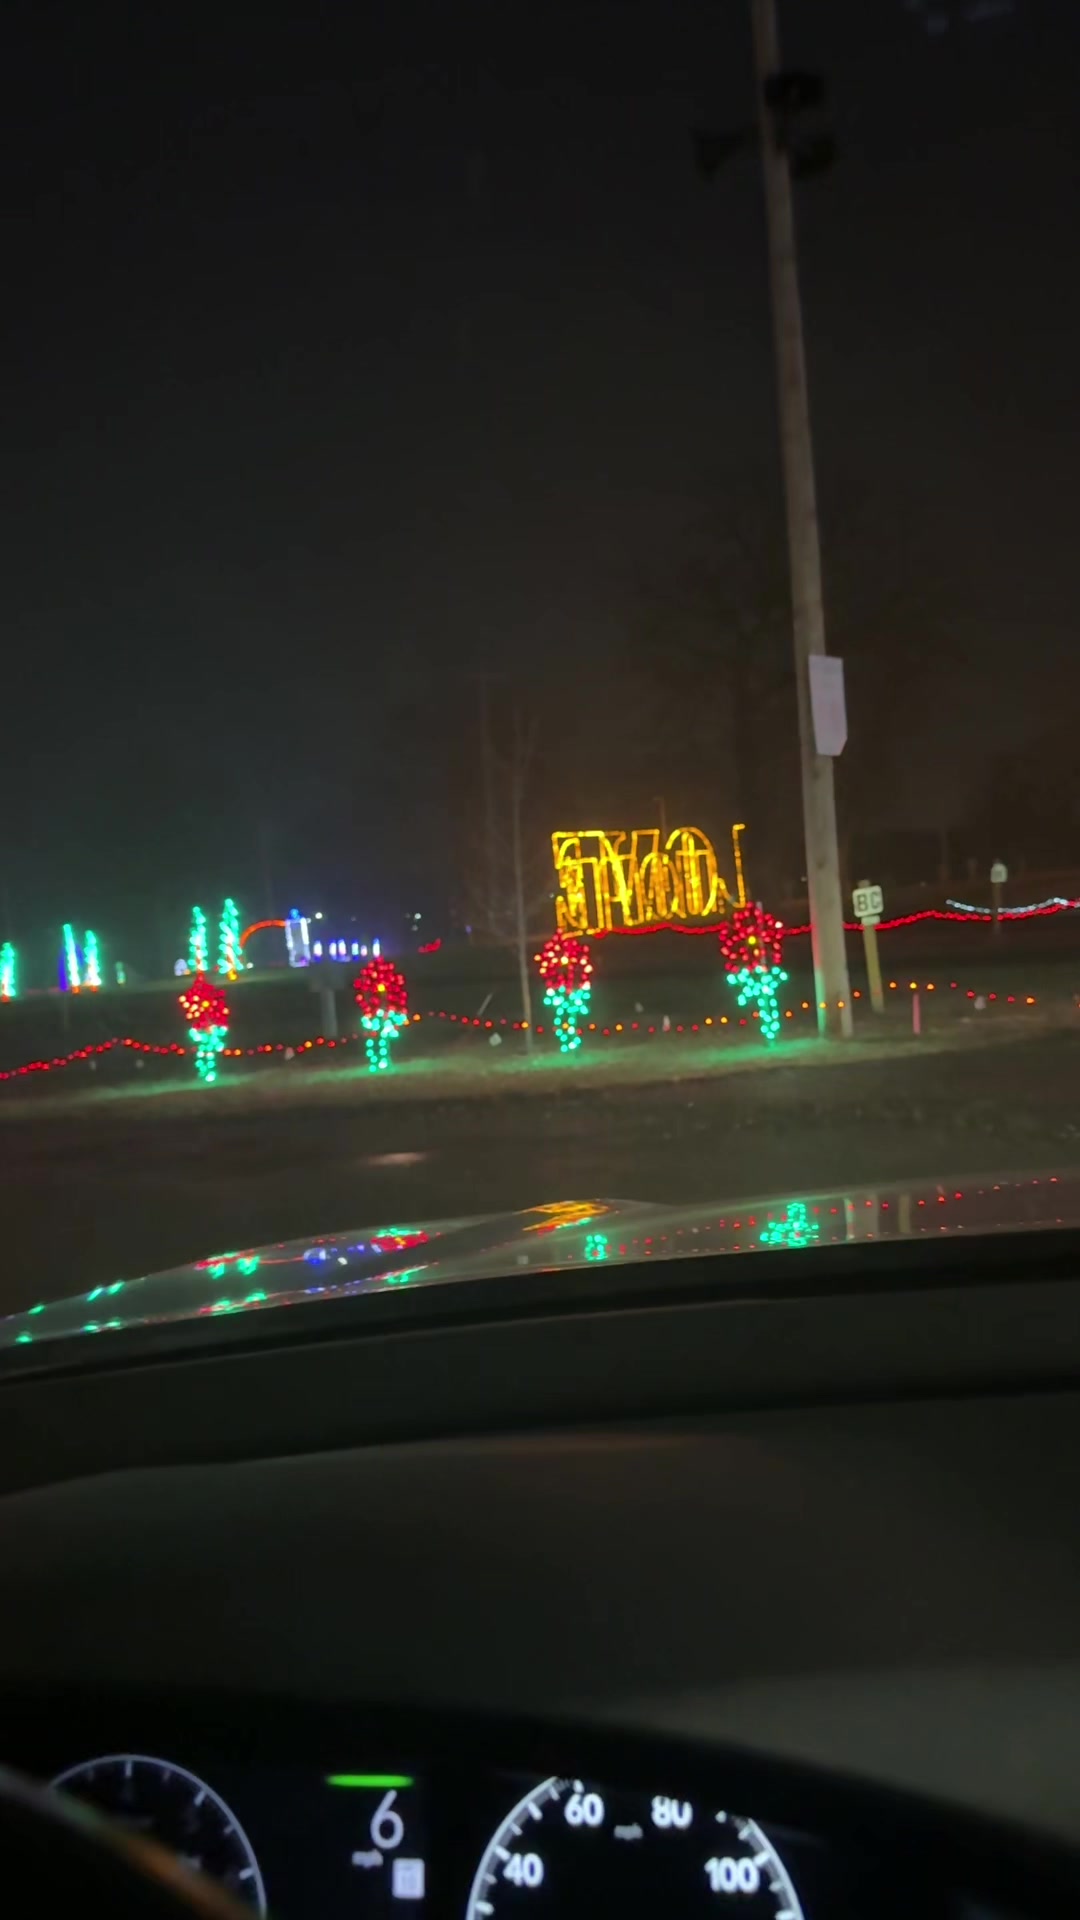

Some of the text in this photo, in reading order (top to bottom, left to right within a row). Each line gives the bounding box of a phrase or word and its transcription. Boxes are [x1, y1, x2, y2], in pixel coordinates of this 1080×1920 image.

[370, 1788, 404, 1850] 6
[564, 1793, 604, 1826] 60
[652, 1795, 693, 1829] 80
[503, 1853, 544, 1888] 40
[705, 1857, 760, 1892] 100
